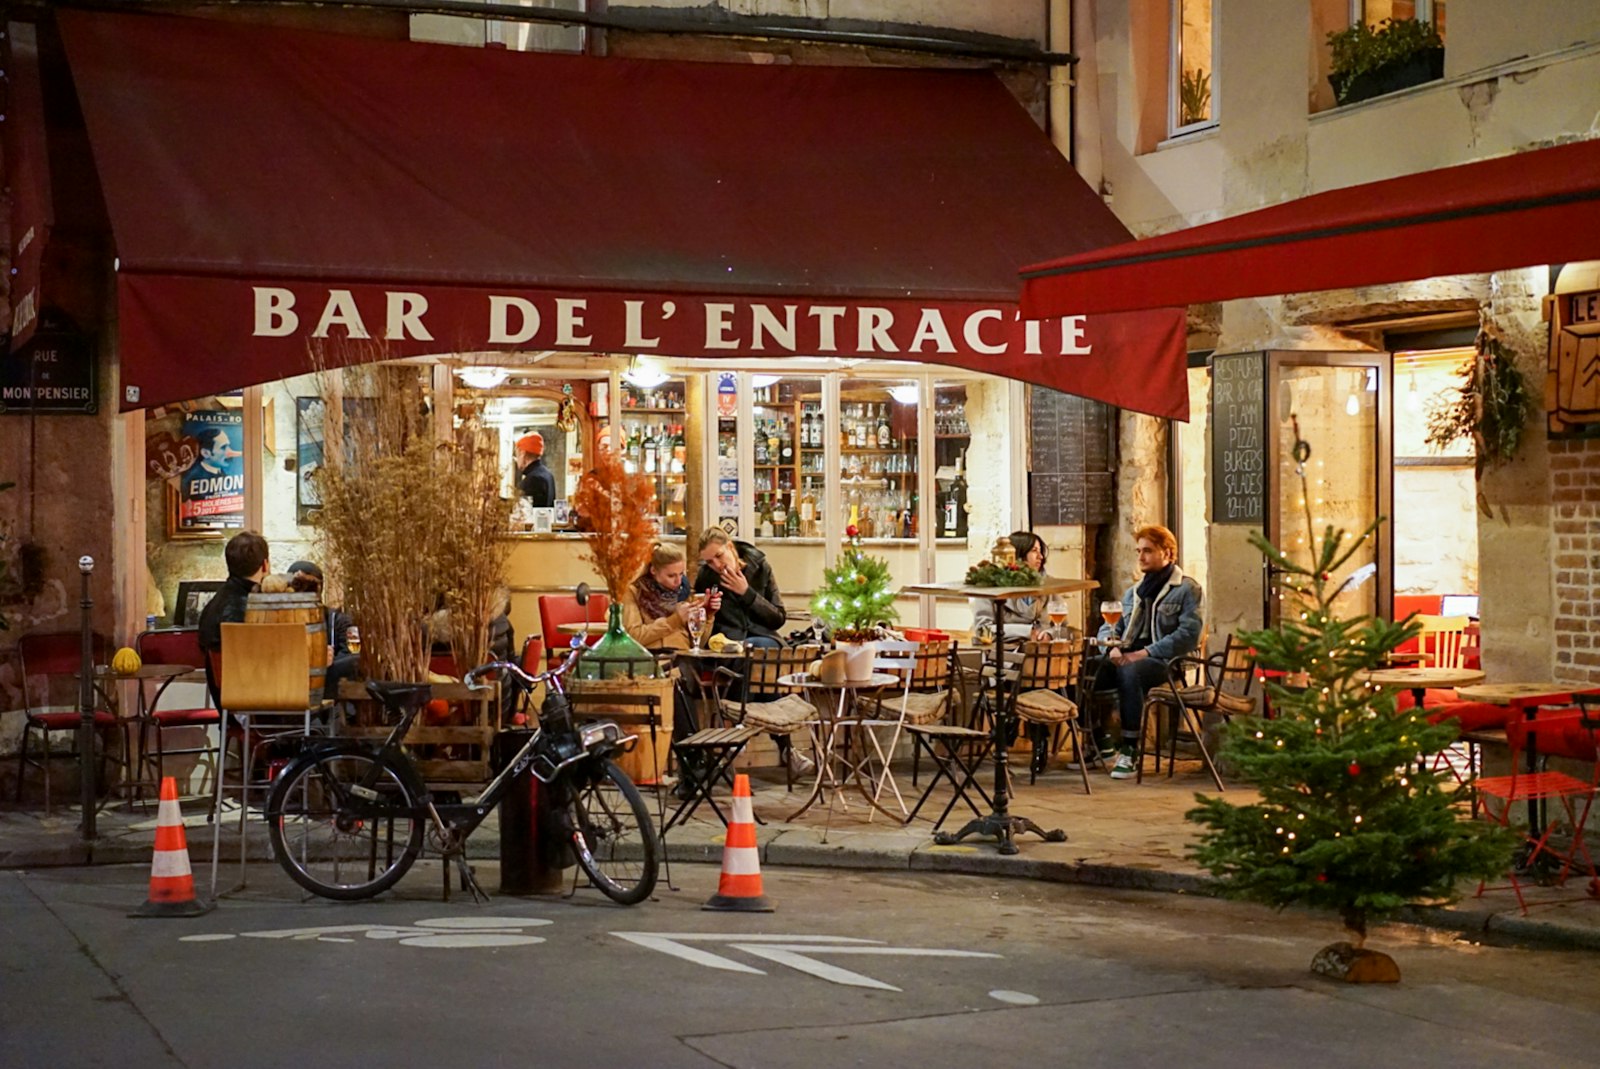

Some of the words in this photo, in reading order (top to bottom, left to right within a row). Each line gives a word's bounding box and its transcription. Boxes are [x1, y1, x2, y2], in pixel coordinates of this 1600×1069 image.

[252, 287, 434, 341] BAR
[488, 295, 593, 347] DE
[1575, 296, 1598, 321] LE
[34, 350, 58, 362] RUE
[1215, 382, 1234, 404] BAR
[1229, 427, 1258, 450] PIZZA
[1224, 450, 1264, 472] BURGERS
[190, 474, 243, 495] EDMON
[1224, 472, 1264, 496] SALADES
[193, 502, 202, 515] 5
